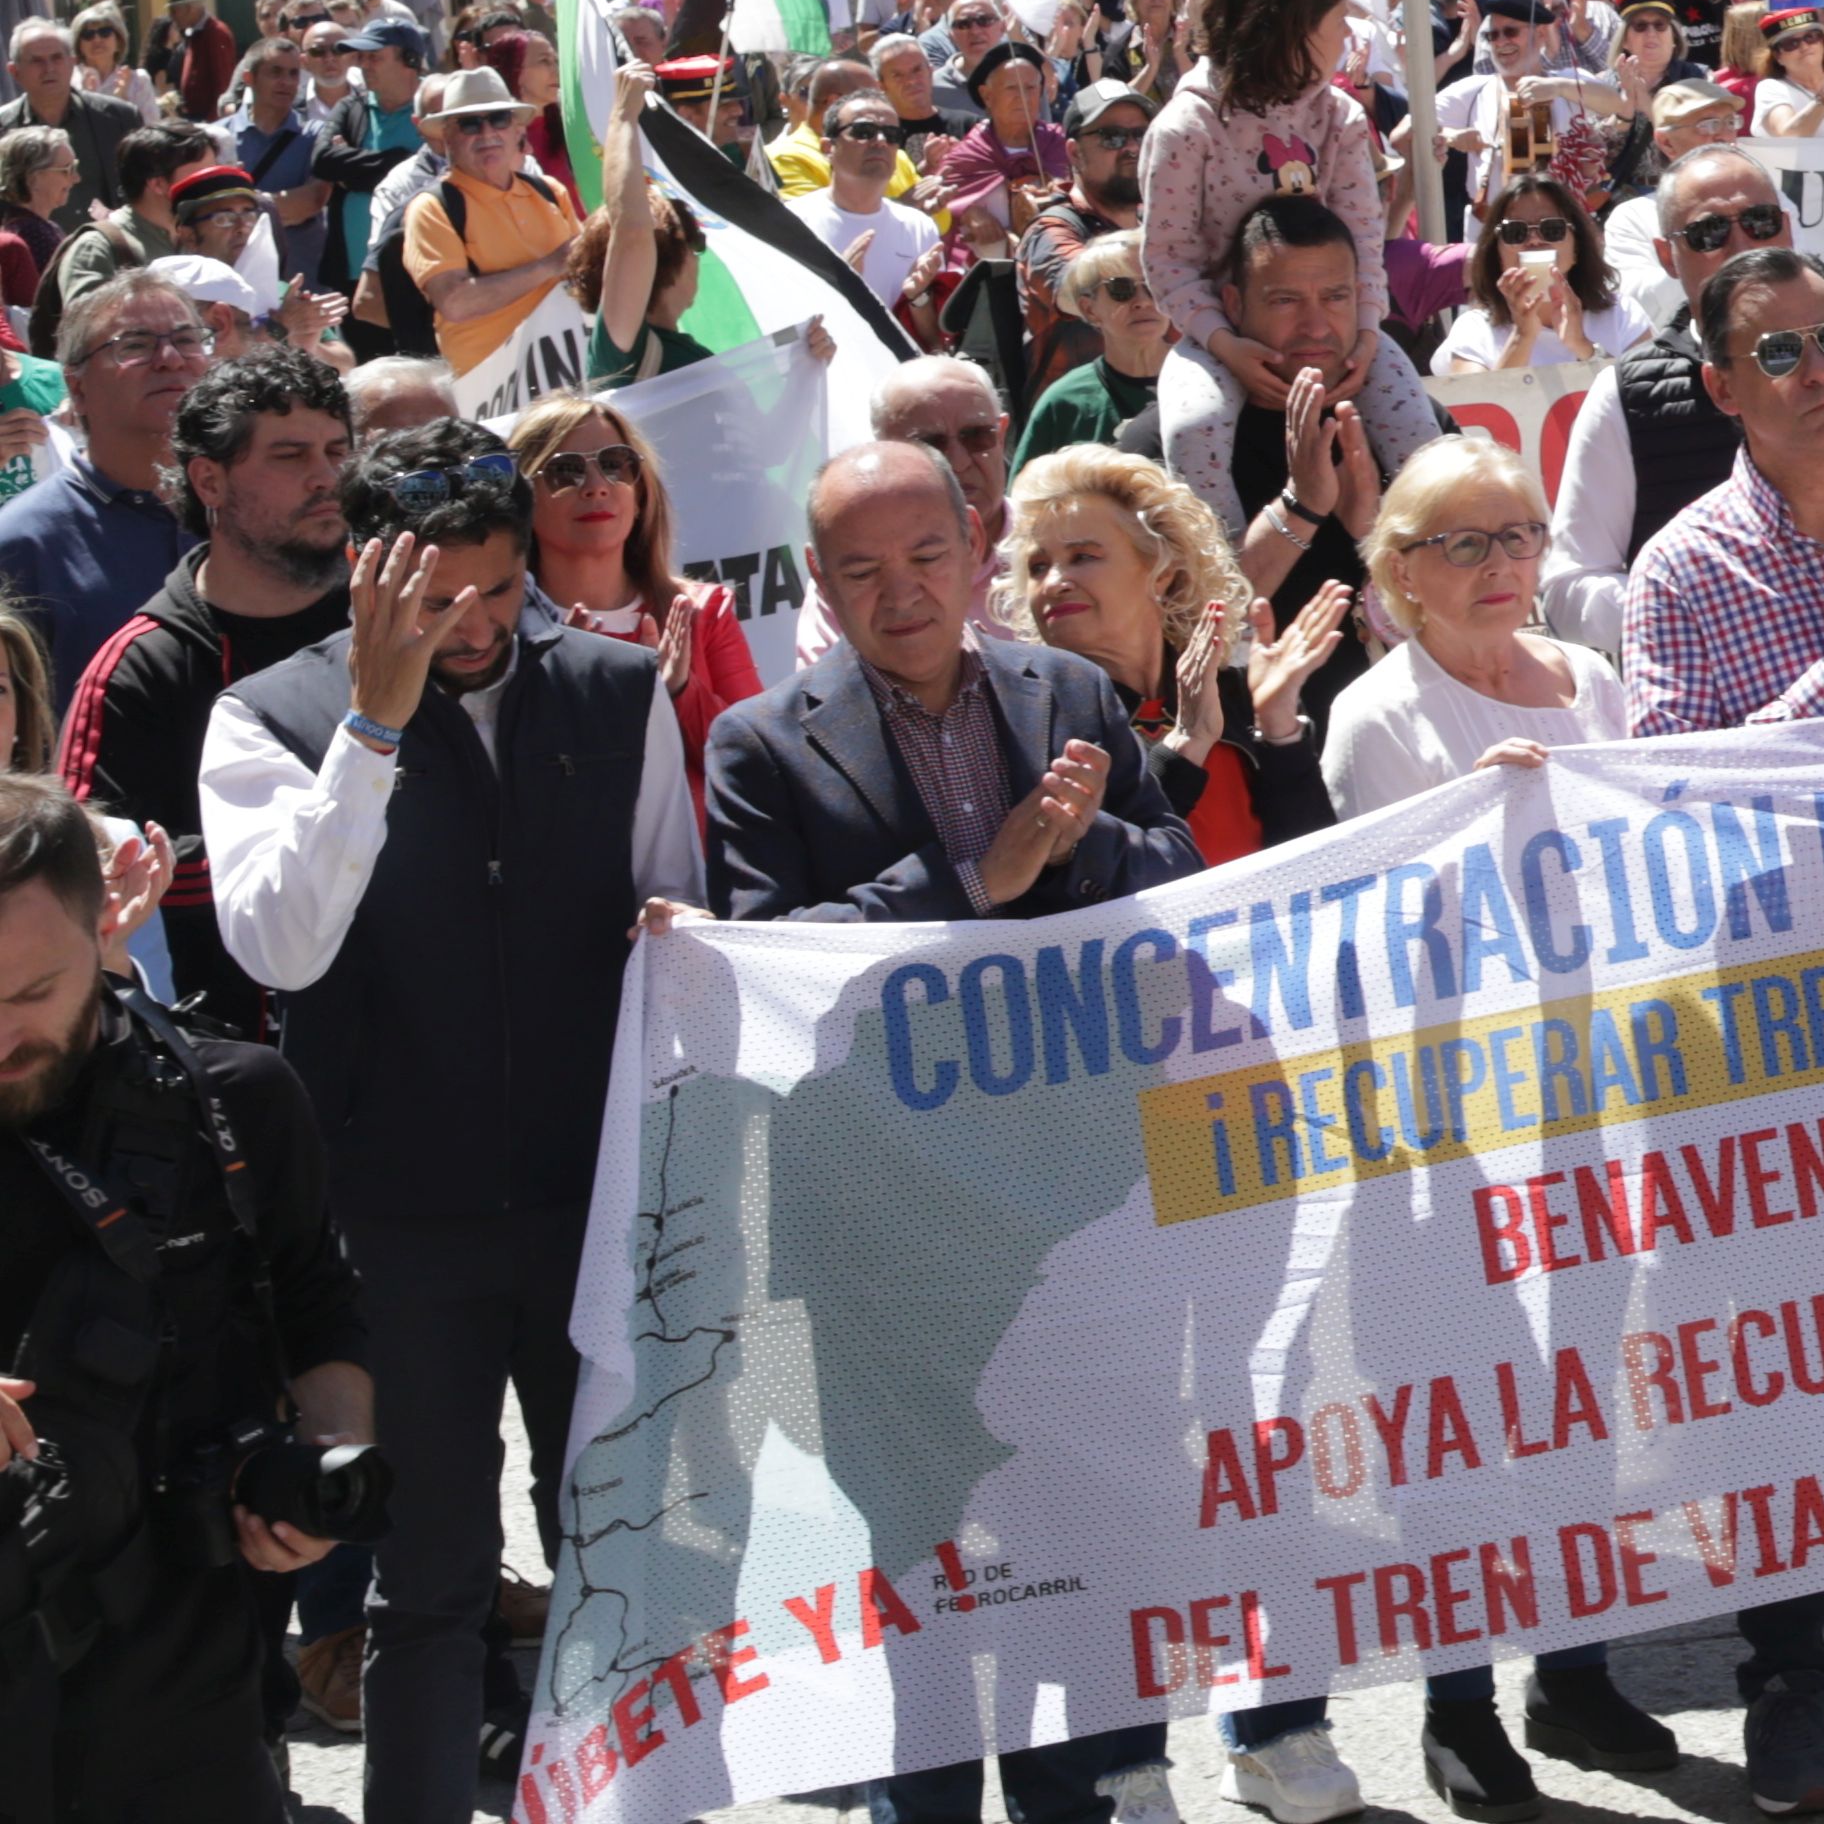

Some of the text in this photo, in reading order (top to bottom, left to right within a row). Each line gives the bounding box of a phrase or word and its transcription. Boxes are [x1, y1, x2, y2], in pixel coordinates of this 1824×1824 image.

[881, 779, 1793, 1112] CONCENTRACIÓN
[29, 1136, 110, 1210] SONY
[1197, 1375, 1483, 1529] APOYA
[1494, 1345, 1609, 1461] LA
[933, 1561, 1014, 1591] RD DE
[933, 1576, 1089, 1615] FEROCARRIL
[1129, 1589, 1291, 1700] DEL
[1314, 1536, 1541, 1666] TREN
[1555, 1509, 1670, 1620] DE
